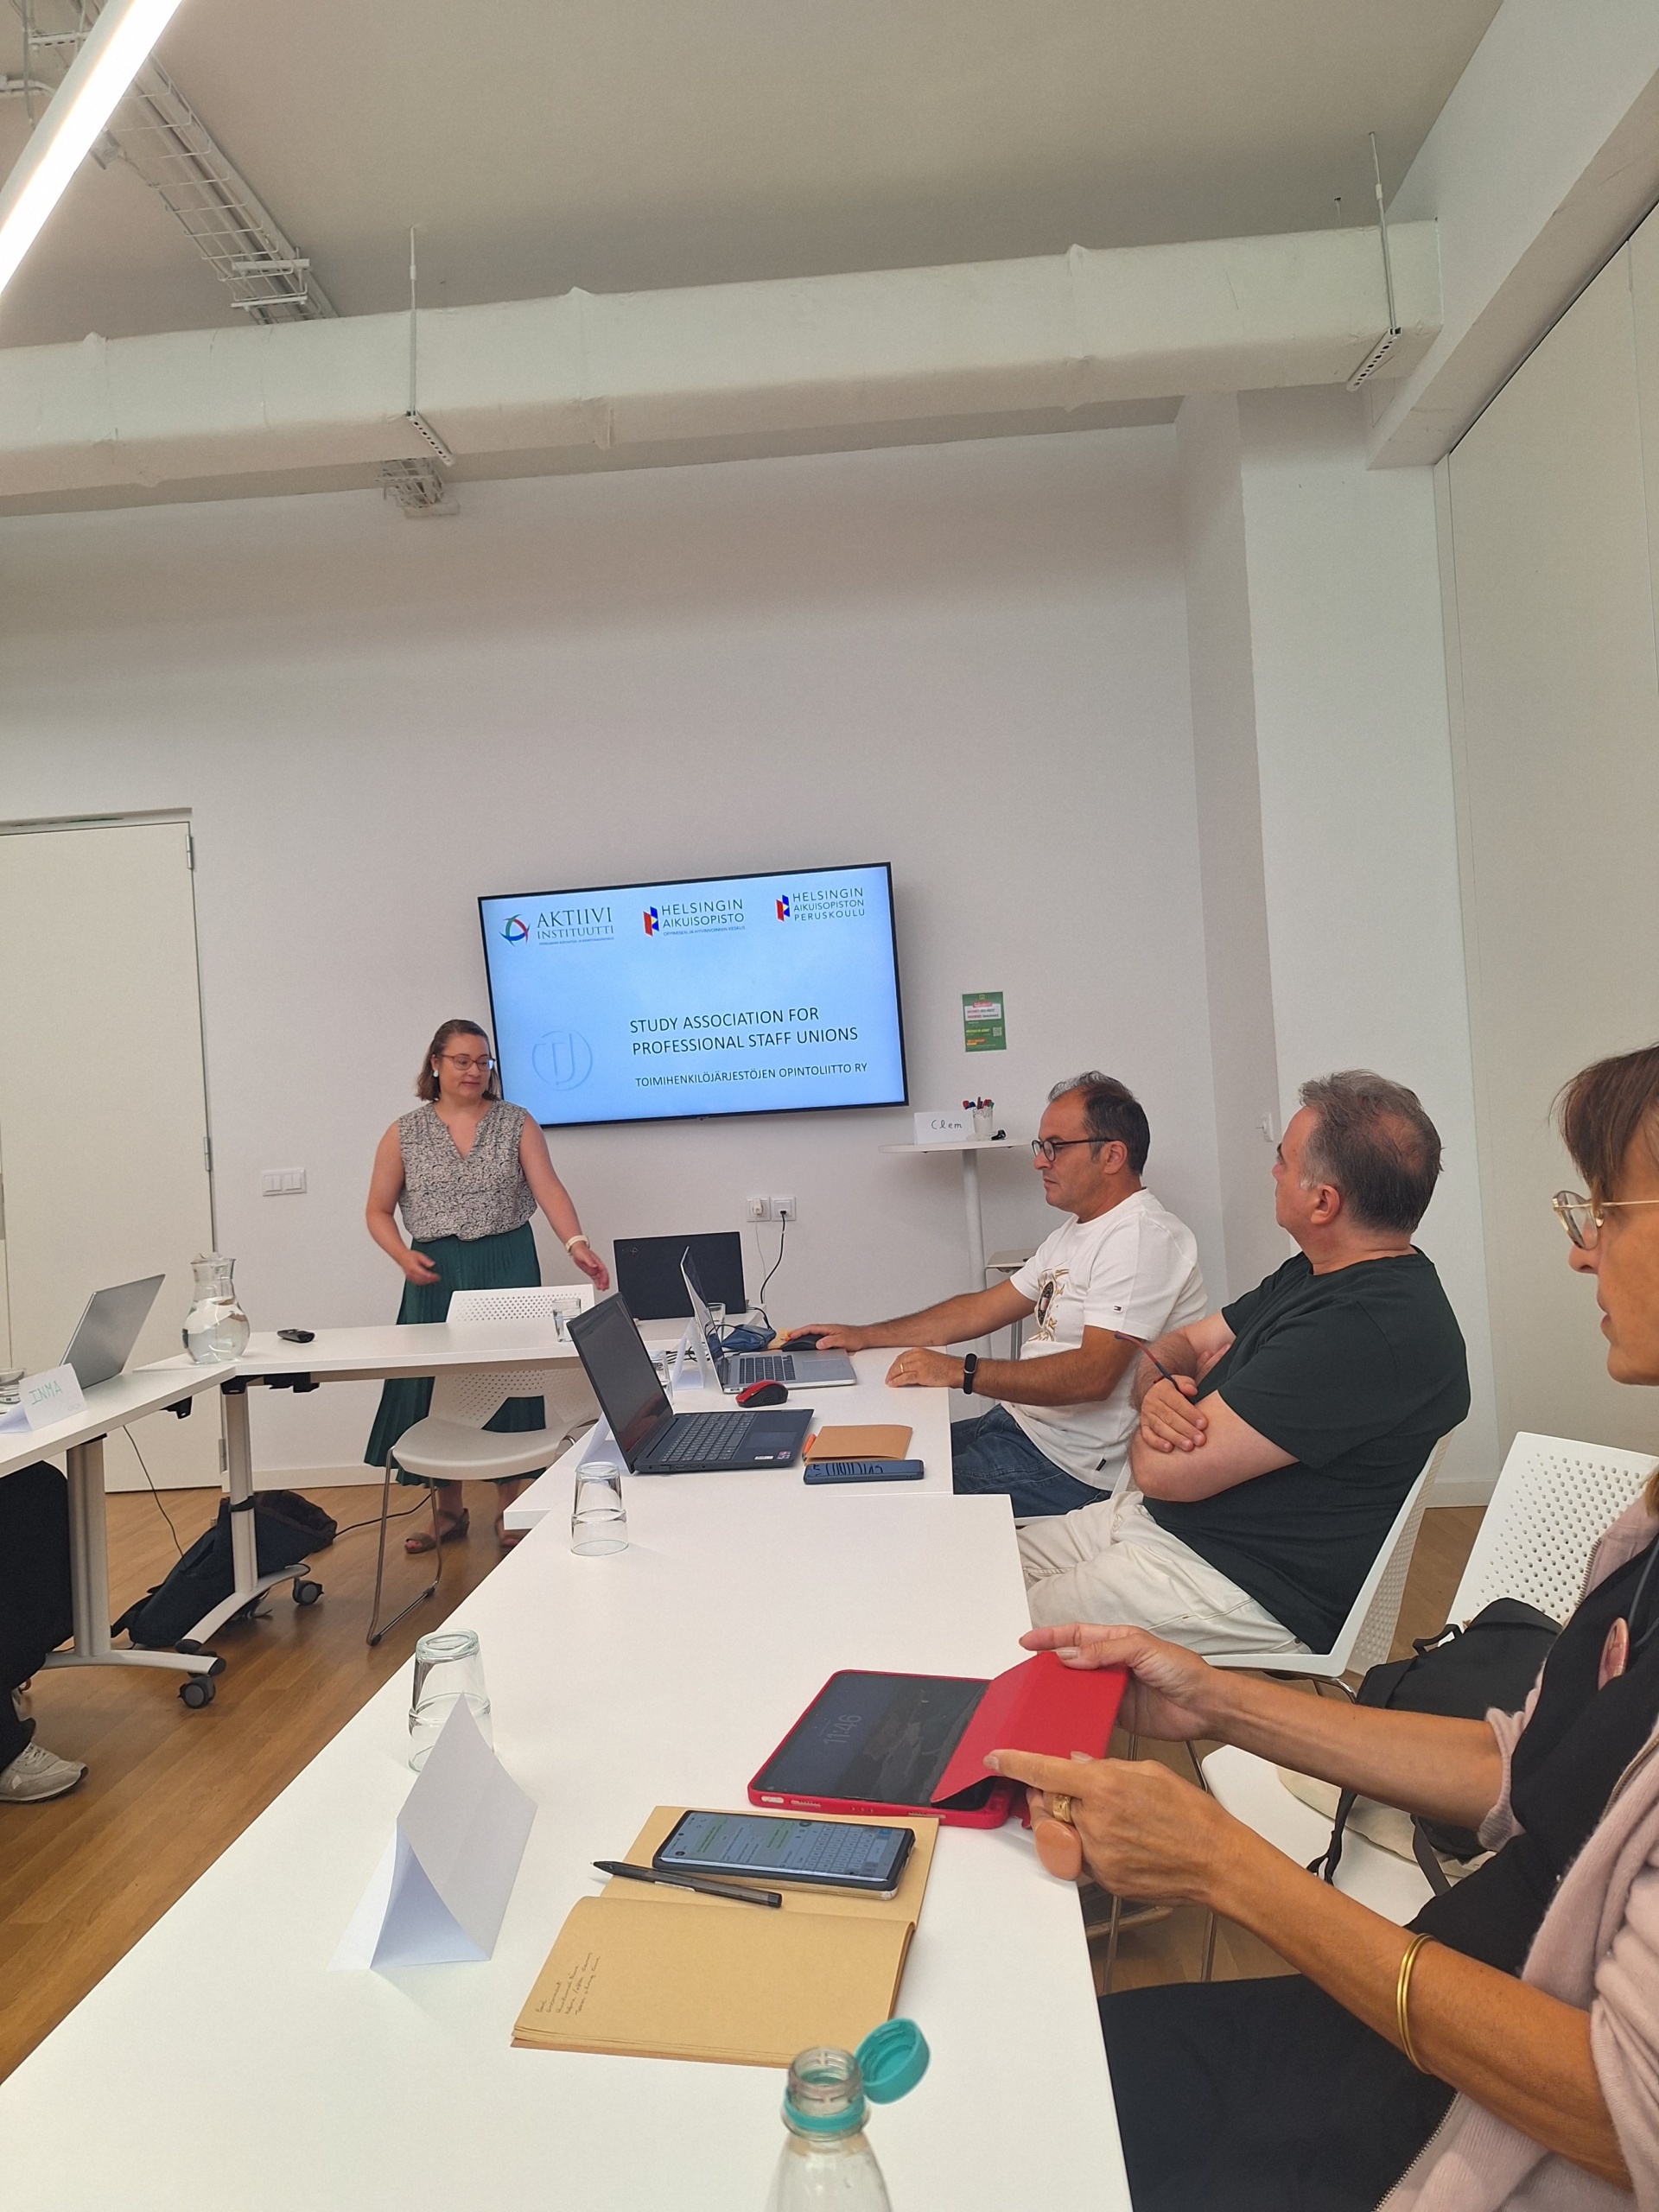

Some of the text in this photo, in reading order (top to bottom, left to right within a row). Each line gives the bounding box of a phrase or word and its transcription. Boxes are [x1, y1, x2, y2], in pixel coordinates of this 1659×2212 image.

[792, 887, 863, 902] HELSINGIN
[661, 899, 743, 916] HELSINGIN
[793, 899, 864, 912] AIKUISOPISTON
[537, 907, 613, 929] AKTIIVI
[663, 912, 745, 929] AIKUISOPISTO
[794, 908, 865, 922] PERUSKOULU
[537, 925, 614, 940] INSTITUUTTI
[630, 1007, 820, 1033] STUDY ASSOCIATION FOR
[632, 1027, 858, 1056] PROFESSIONAL STAFF UNIONS
[635, 1062, 868, 1087] TOIMIHENKILÖJÄRJESTÖJEN OPINTOLIITTO RY
[931, 1119, 963, 1130] Clem
[29, 1380, 63, 1406] INMA
[823, 1714, 862, 1745] 11:46
